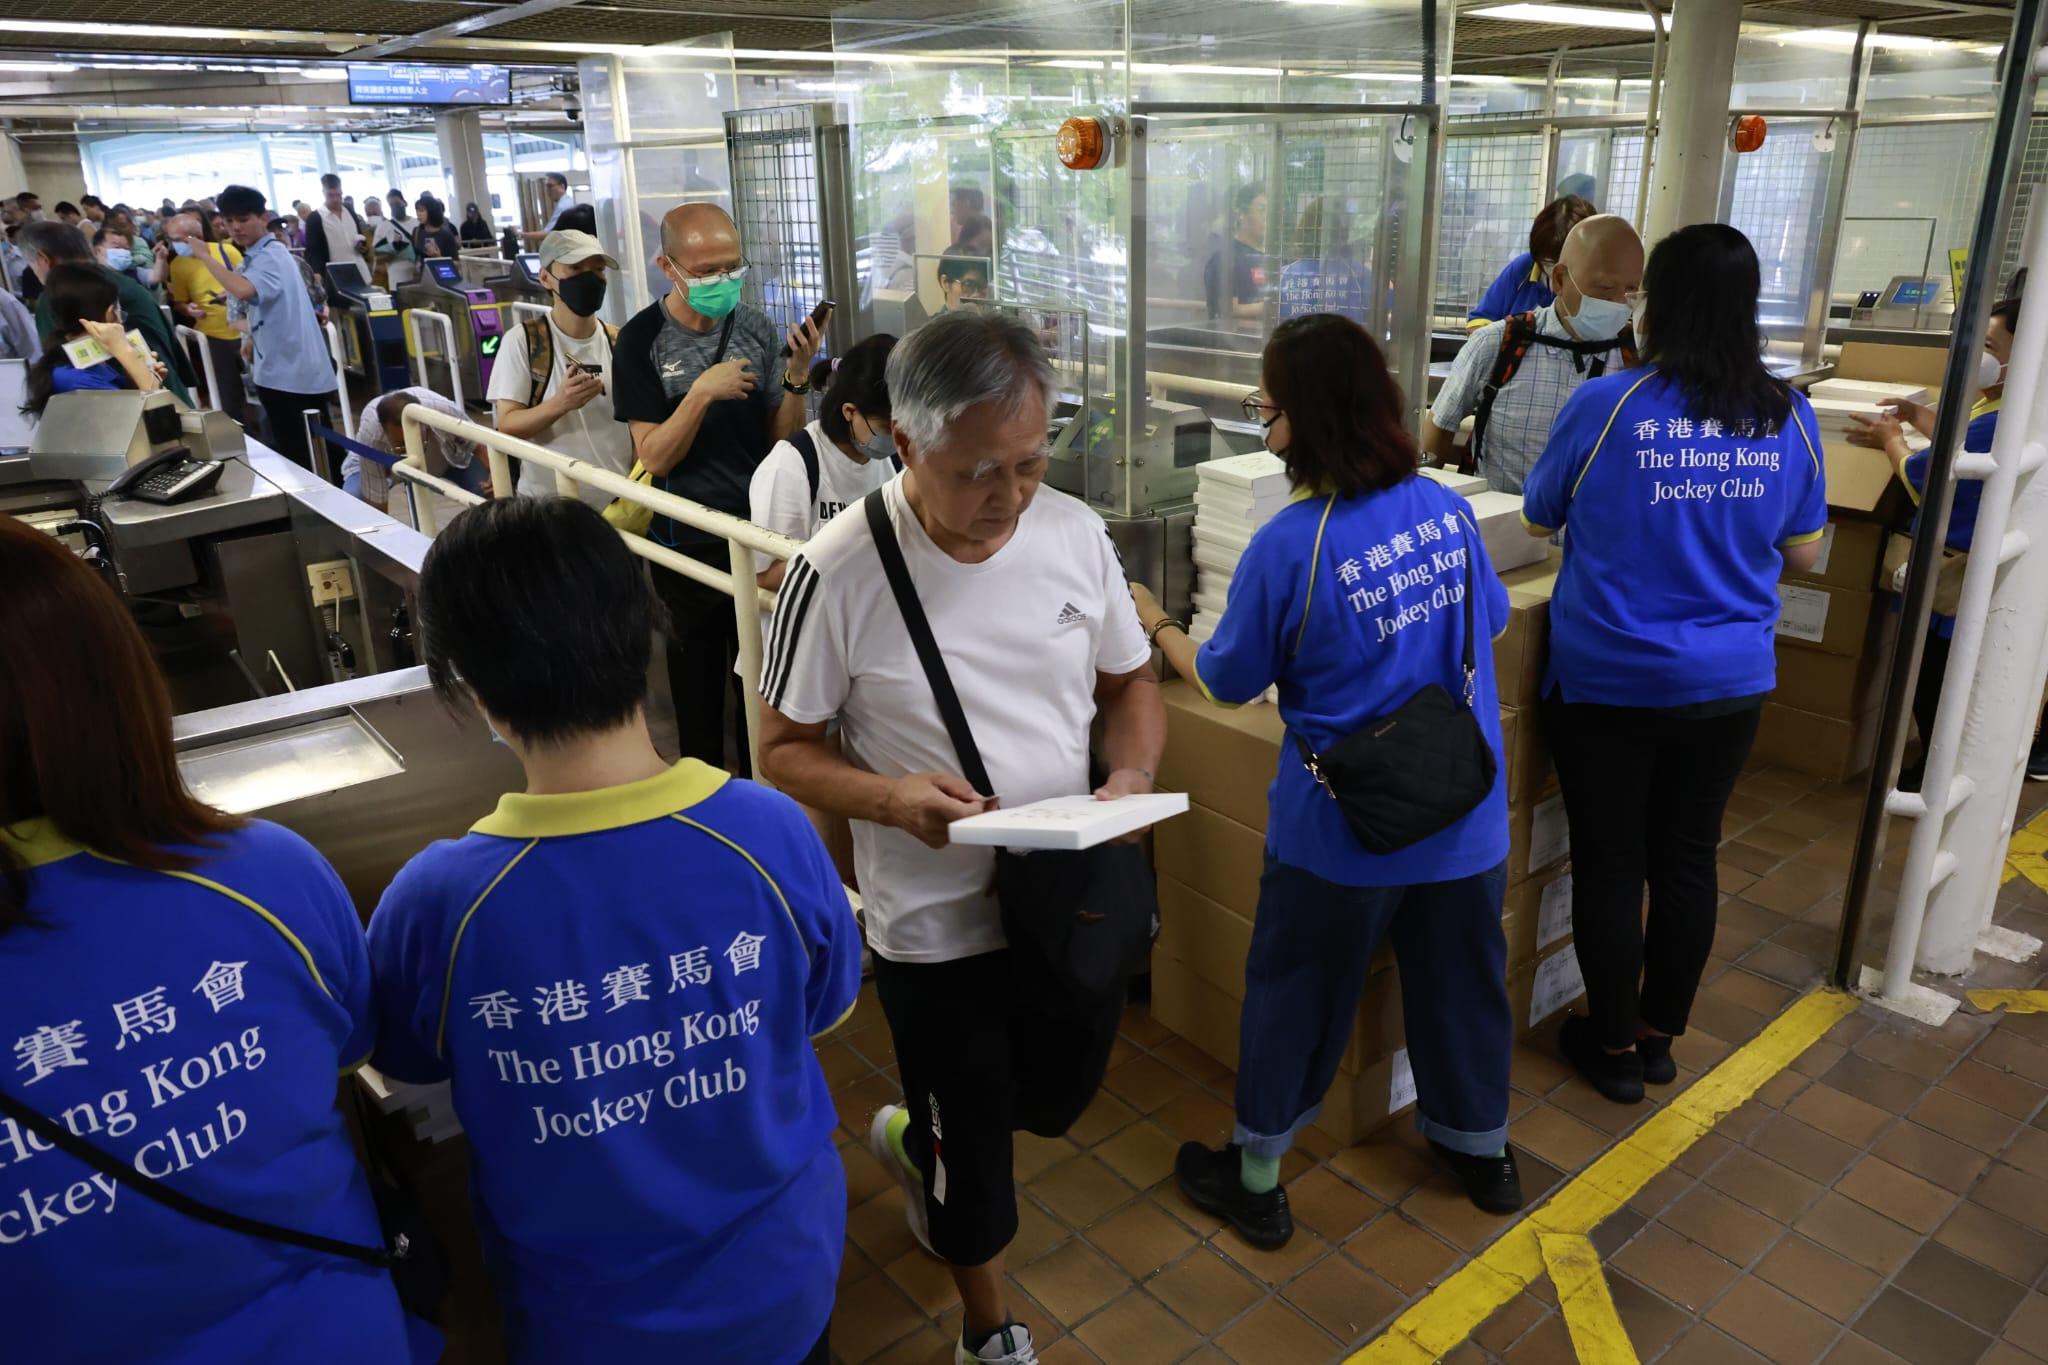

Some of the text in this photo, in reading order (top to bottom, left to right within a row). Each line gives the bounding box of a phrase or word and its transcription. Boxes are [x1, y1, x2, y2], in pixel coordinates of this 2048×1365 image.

[1636, 447, 1780, 472] The Hong Kong
[1650, 477, 1765, 505] Jockey Club
[1335, 512, 1460, 586] 香港賽馬會
[1347, 547, 1467, 613] The Hong Kong
[1375, 578, 1465, 642] Jockey Club
[468, 930, 767, 1029] 香港賽馬會
[13, 960, 249, 1087] 賽馬會
[488, 999, 761, 1084] The Hong Kong
[140, 1025, 266, 1109] Kong
[532, 1057, 747, 1144] Jockey Club
[133, 1101, 248, 1180] Club
